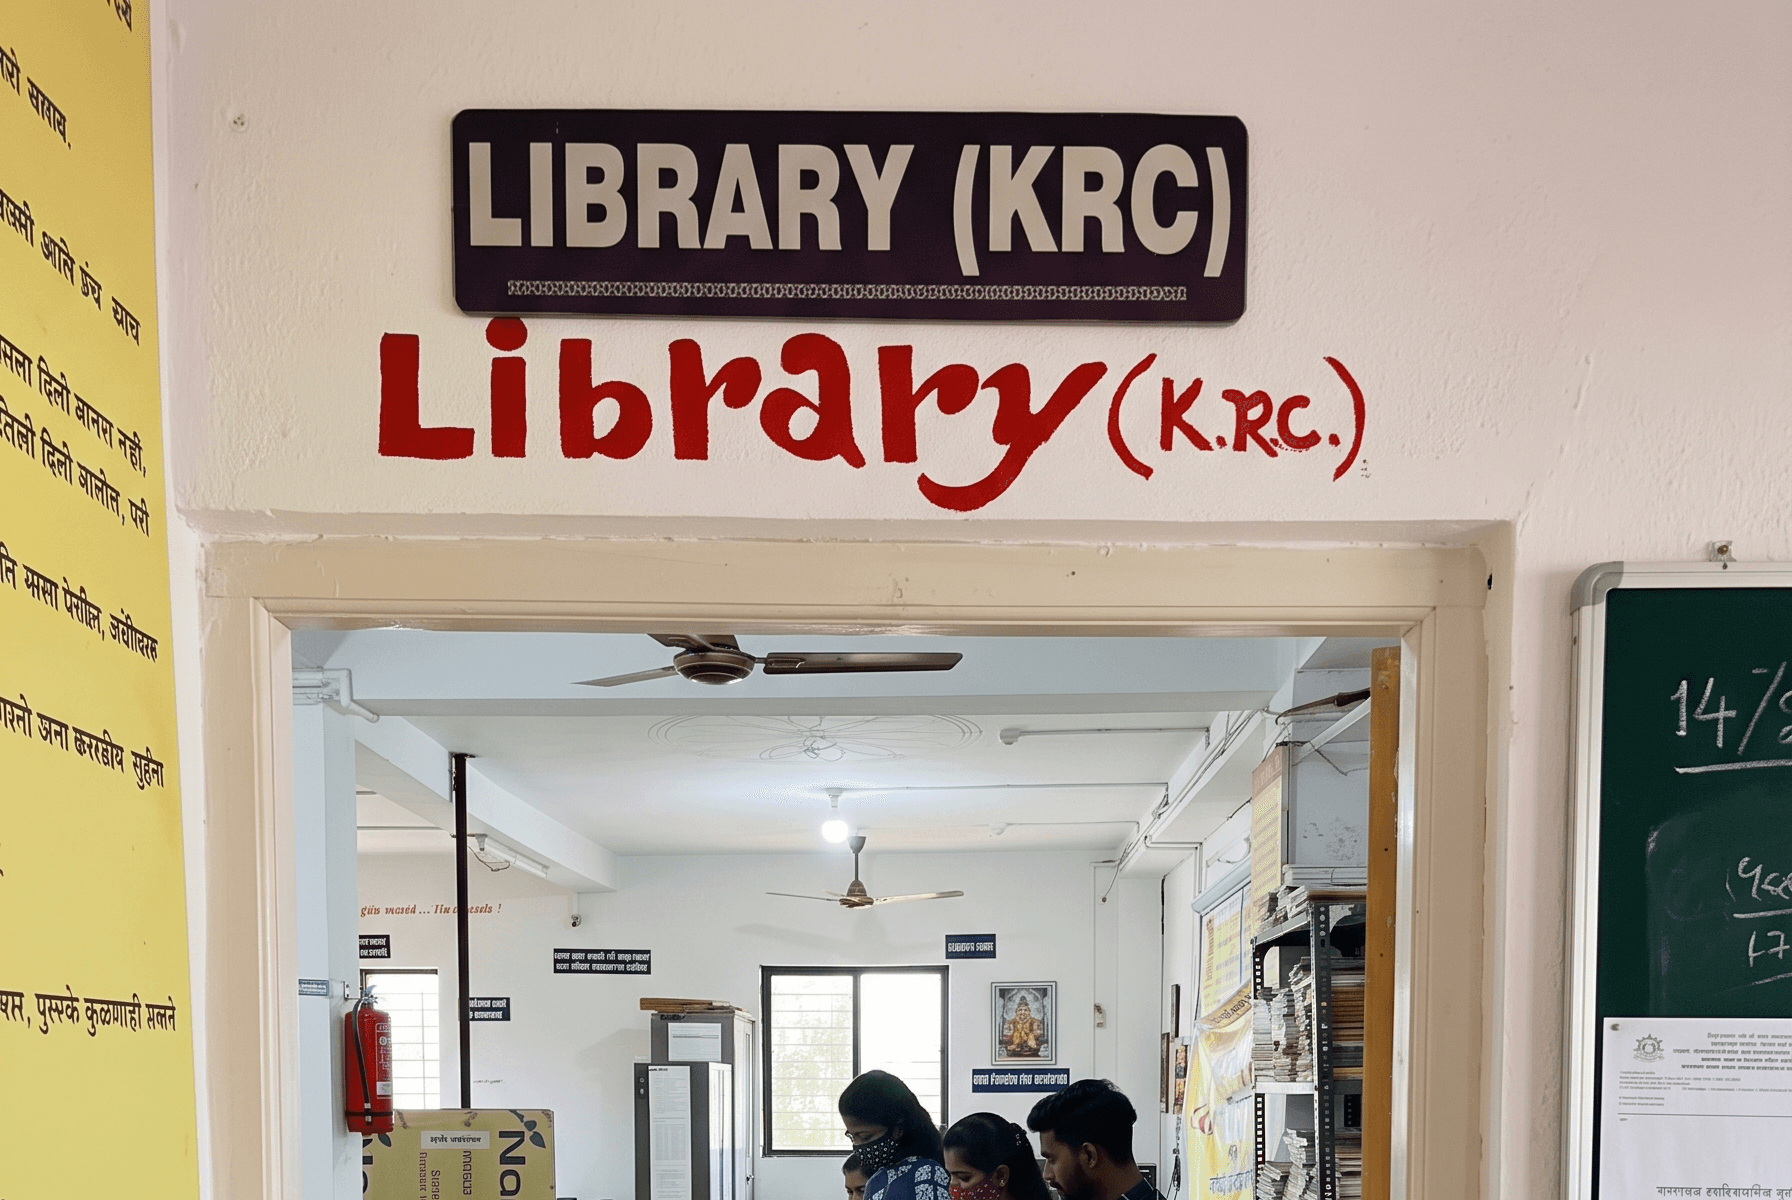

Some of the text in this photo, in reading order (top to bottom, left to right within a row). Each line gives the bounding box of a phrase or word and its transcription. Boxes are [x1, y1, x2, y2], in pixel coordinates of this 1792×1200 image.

[468, 142, 1231, 278] LIBRARY (KRC)
[379, 316, 1107, 512] Library
